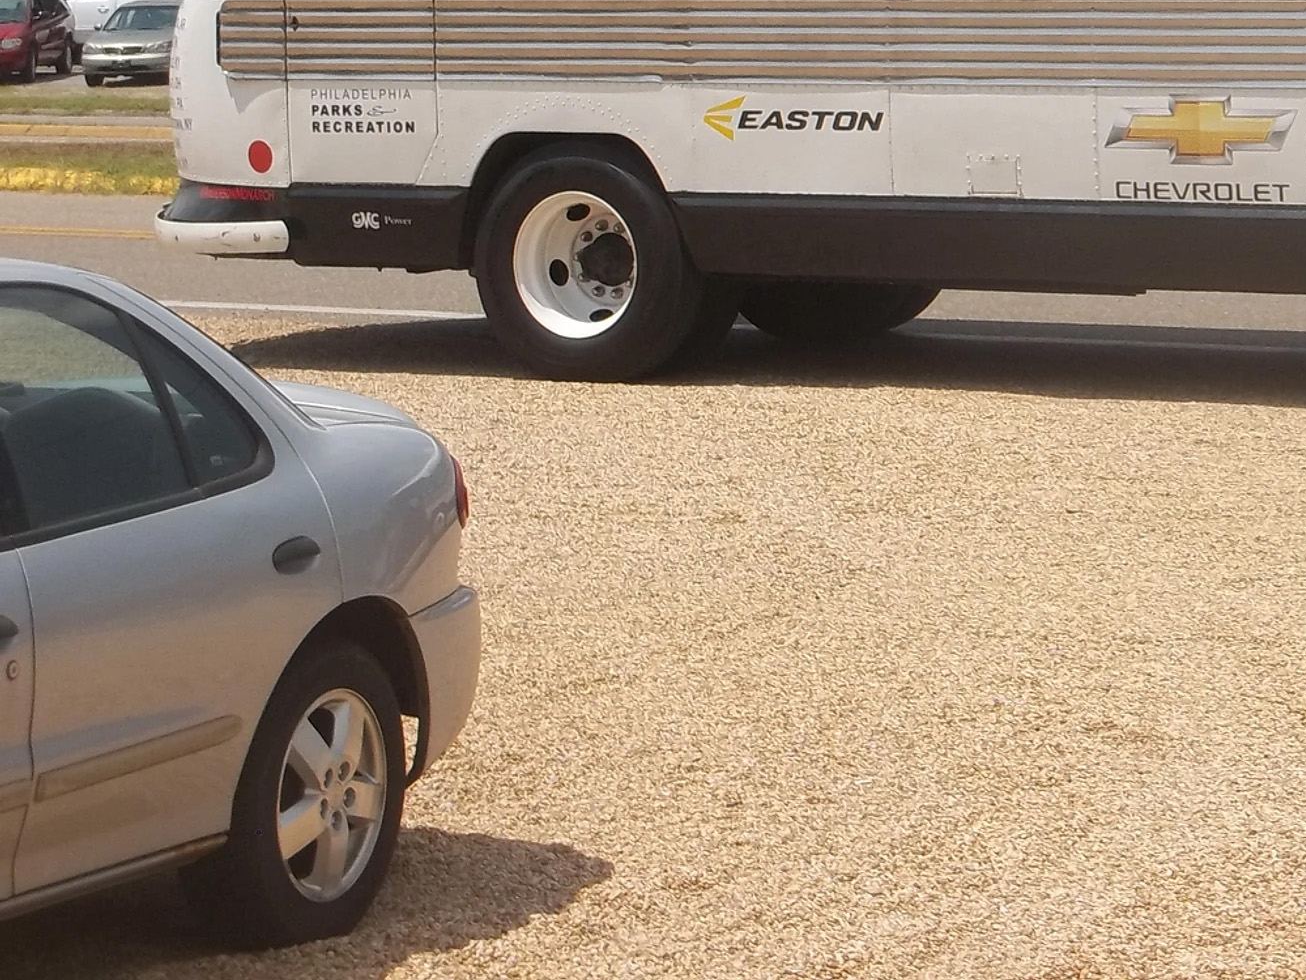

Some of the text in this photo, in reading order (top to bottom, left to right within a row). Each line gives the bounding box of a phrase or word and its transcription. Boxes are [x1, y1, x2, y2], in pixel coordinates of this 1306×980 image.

[311, 89, 412, 100] PHILADELPHIA
[312, 105, 363, 116] PARKS
[312, 122, 415, 133] RECREATION
[737, 111, 884, 131] EASTON
[1115, 181, 1290, 202] CHEVROLET
[352, 211, 380, 229] GMC
